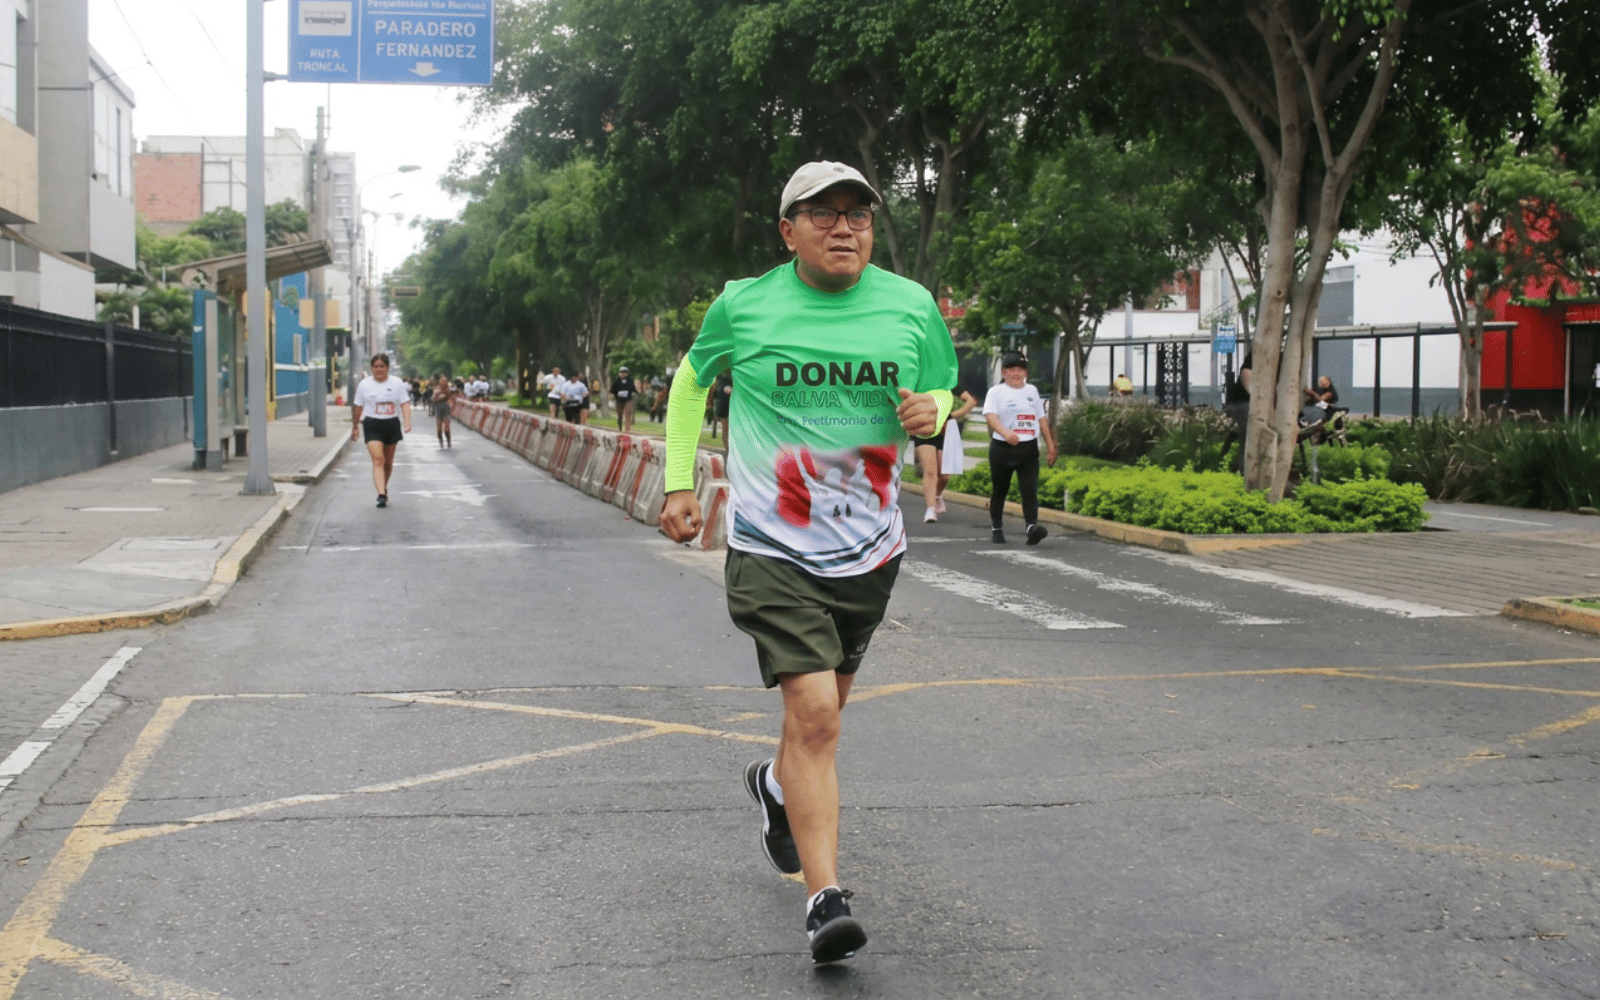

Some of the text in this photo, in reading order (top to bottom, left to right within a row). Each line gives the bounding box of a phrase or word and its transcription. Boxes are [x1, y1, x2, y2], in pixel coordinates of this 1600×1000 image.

[375, 20, 477, 37] PARADERO
[376, 43, 477, 58] FERNANDEZ
[298, 61, 349, 73] TRONCAL
[776, 361, 899, 387] DONAR
[771, 390, 842, 408] SALVA
